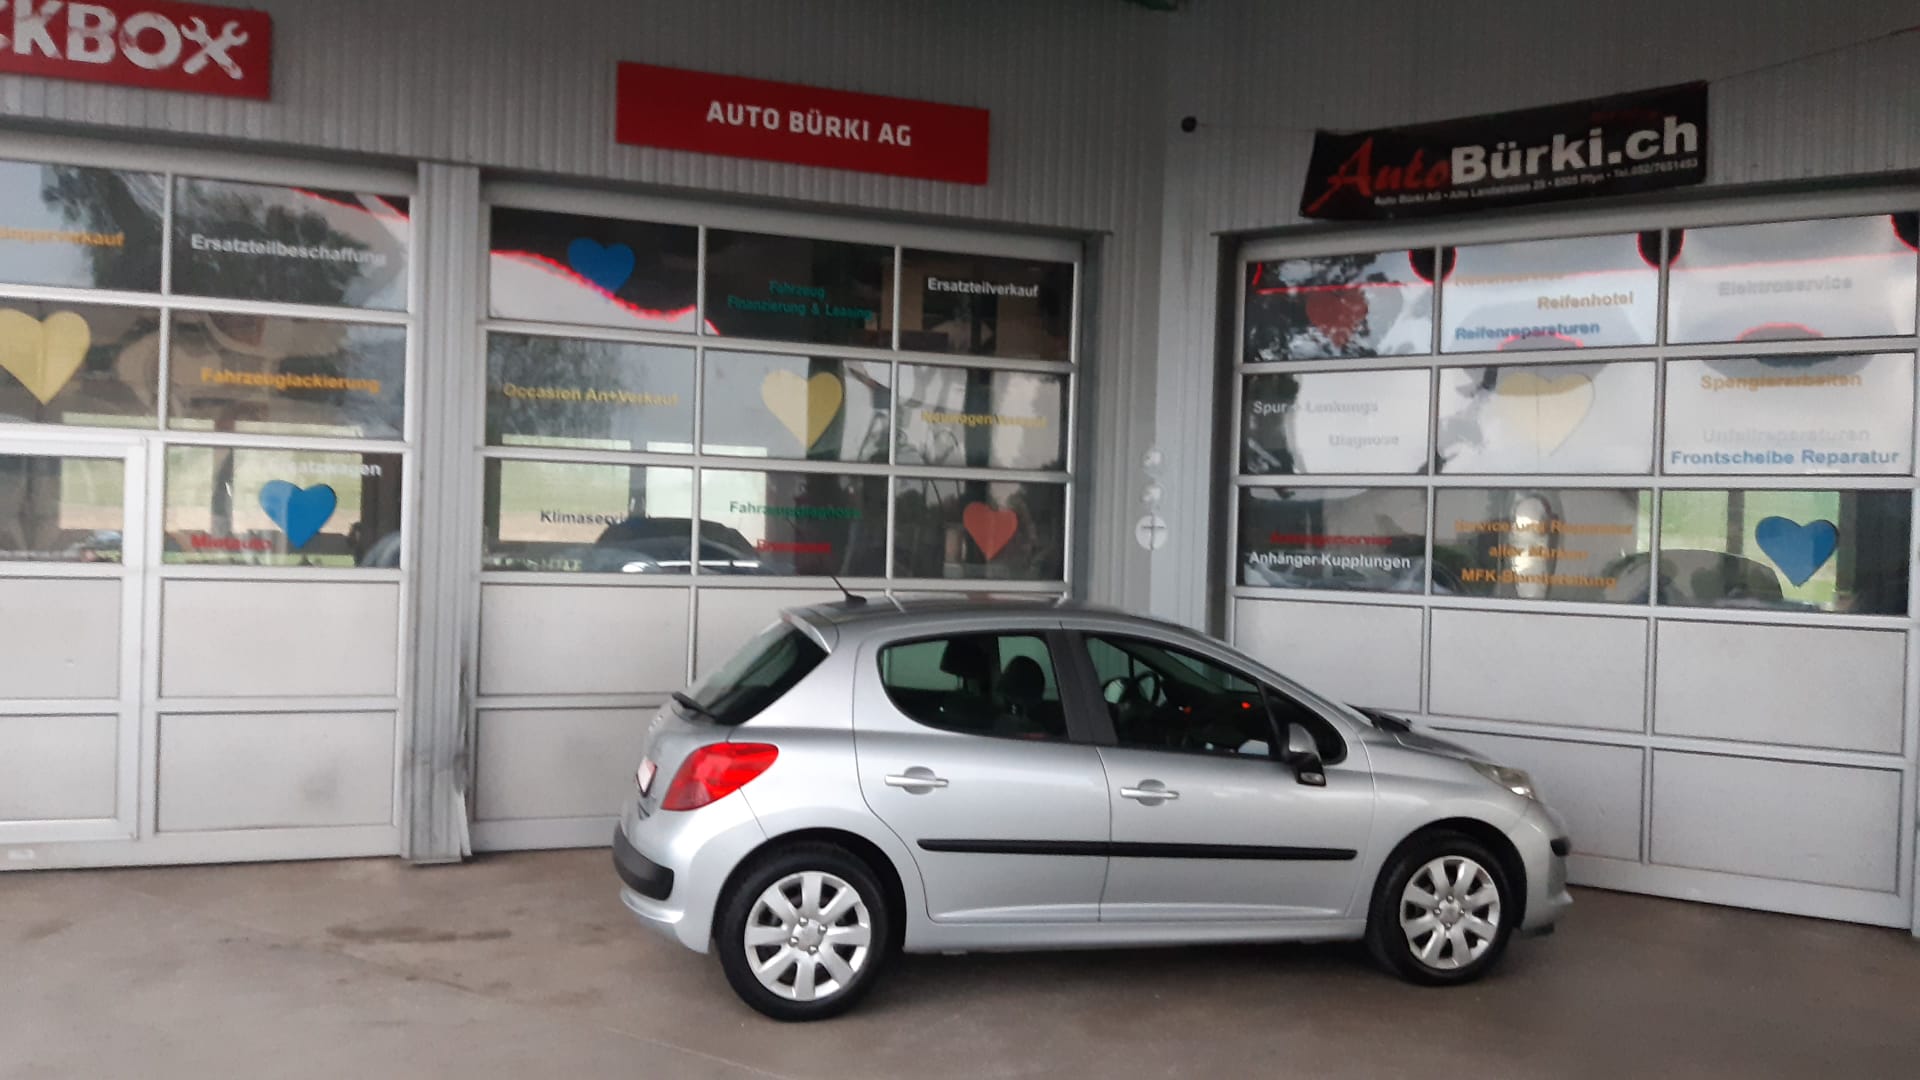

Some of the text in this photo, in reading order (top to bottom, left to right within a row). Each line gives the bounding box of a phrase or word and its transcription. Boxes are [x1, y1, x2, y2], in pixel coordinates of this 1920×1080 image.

[0, 0, 248, 80] KBOX
[706, 100, 912, 147] AUTO BÜRKI AG
[191, 233, 387, 267] Ersatzteilbeschaffung
[927, 277, 1039, 298] Ersatzteilverkauf
[1718, 275, 1853, 296] Elektroservice
[1537, 291, 1635, 311] Reifenhotel
[1455, 320, 1600, 342] Reifenreparaturen
[201, 367, 381, 394] Fahrzeuglackierung
[503, 382, 581, 401] Occasion
[1253, 400, 1288, 417] Spur
[1305, 400, 1379, 417] Lenkungs
[1328, 432, 1400, 449] Diagnose
[1671, 448, 1900, 466] Frontscheibe Reparatur
[1249, 550, 1411, 572] Anhänger Kupplungen
